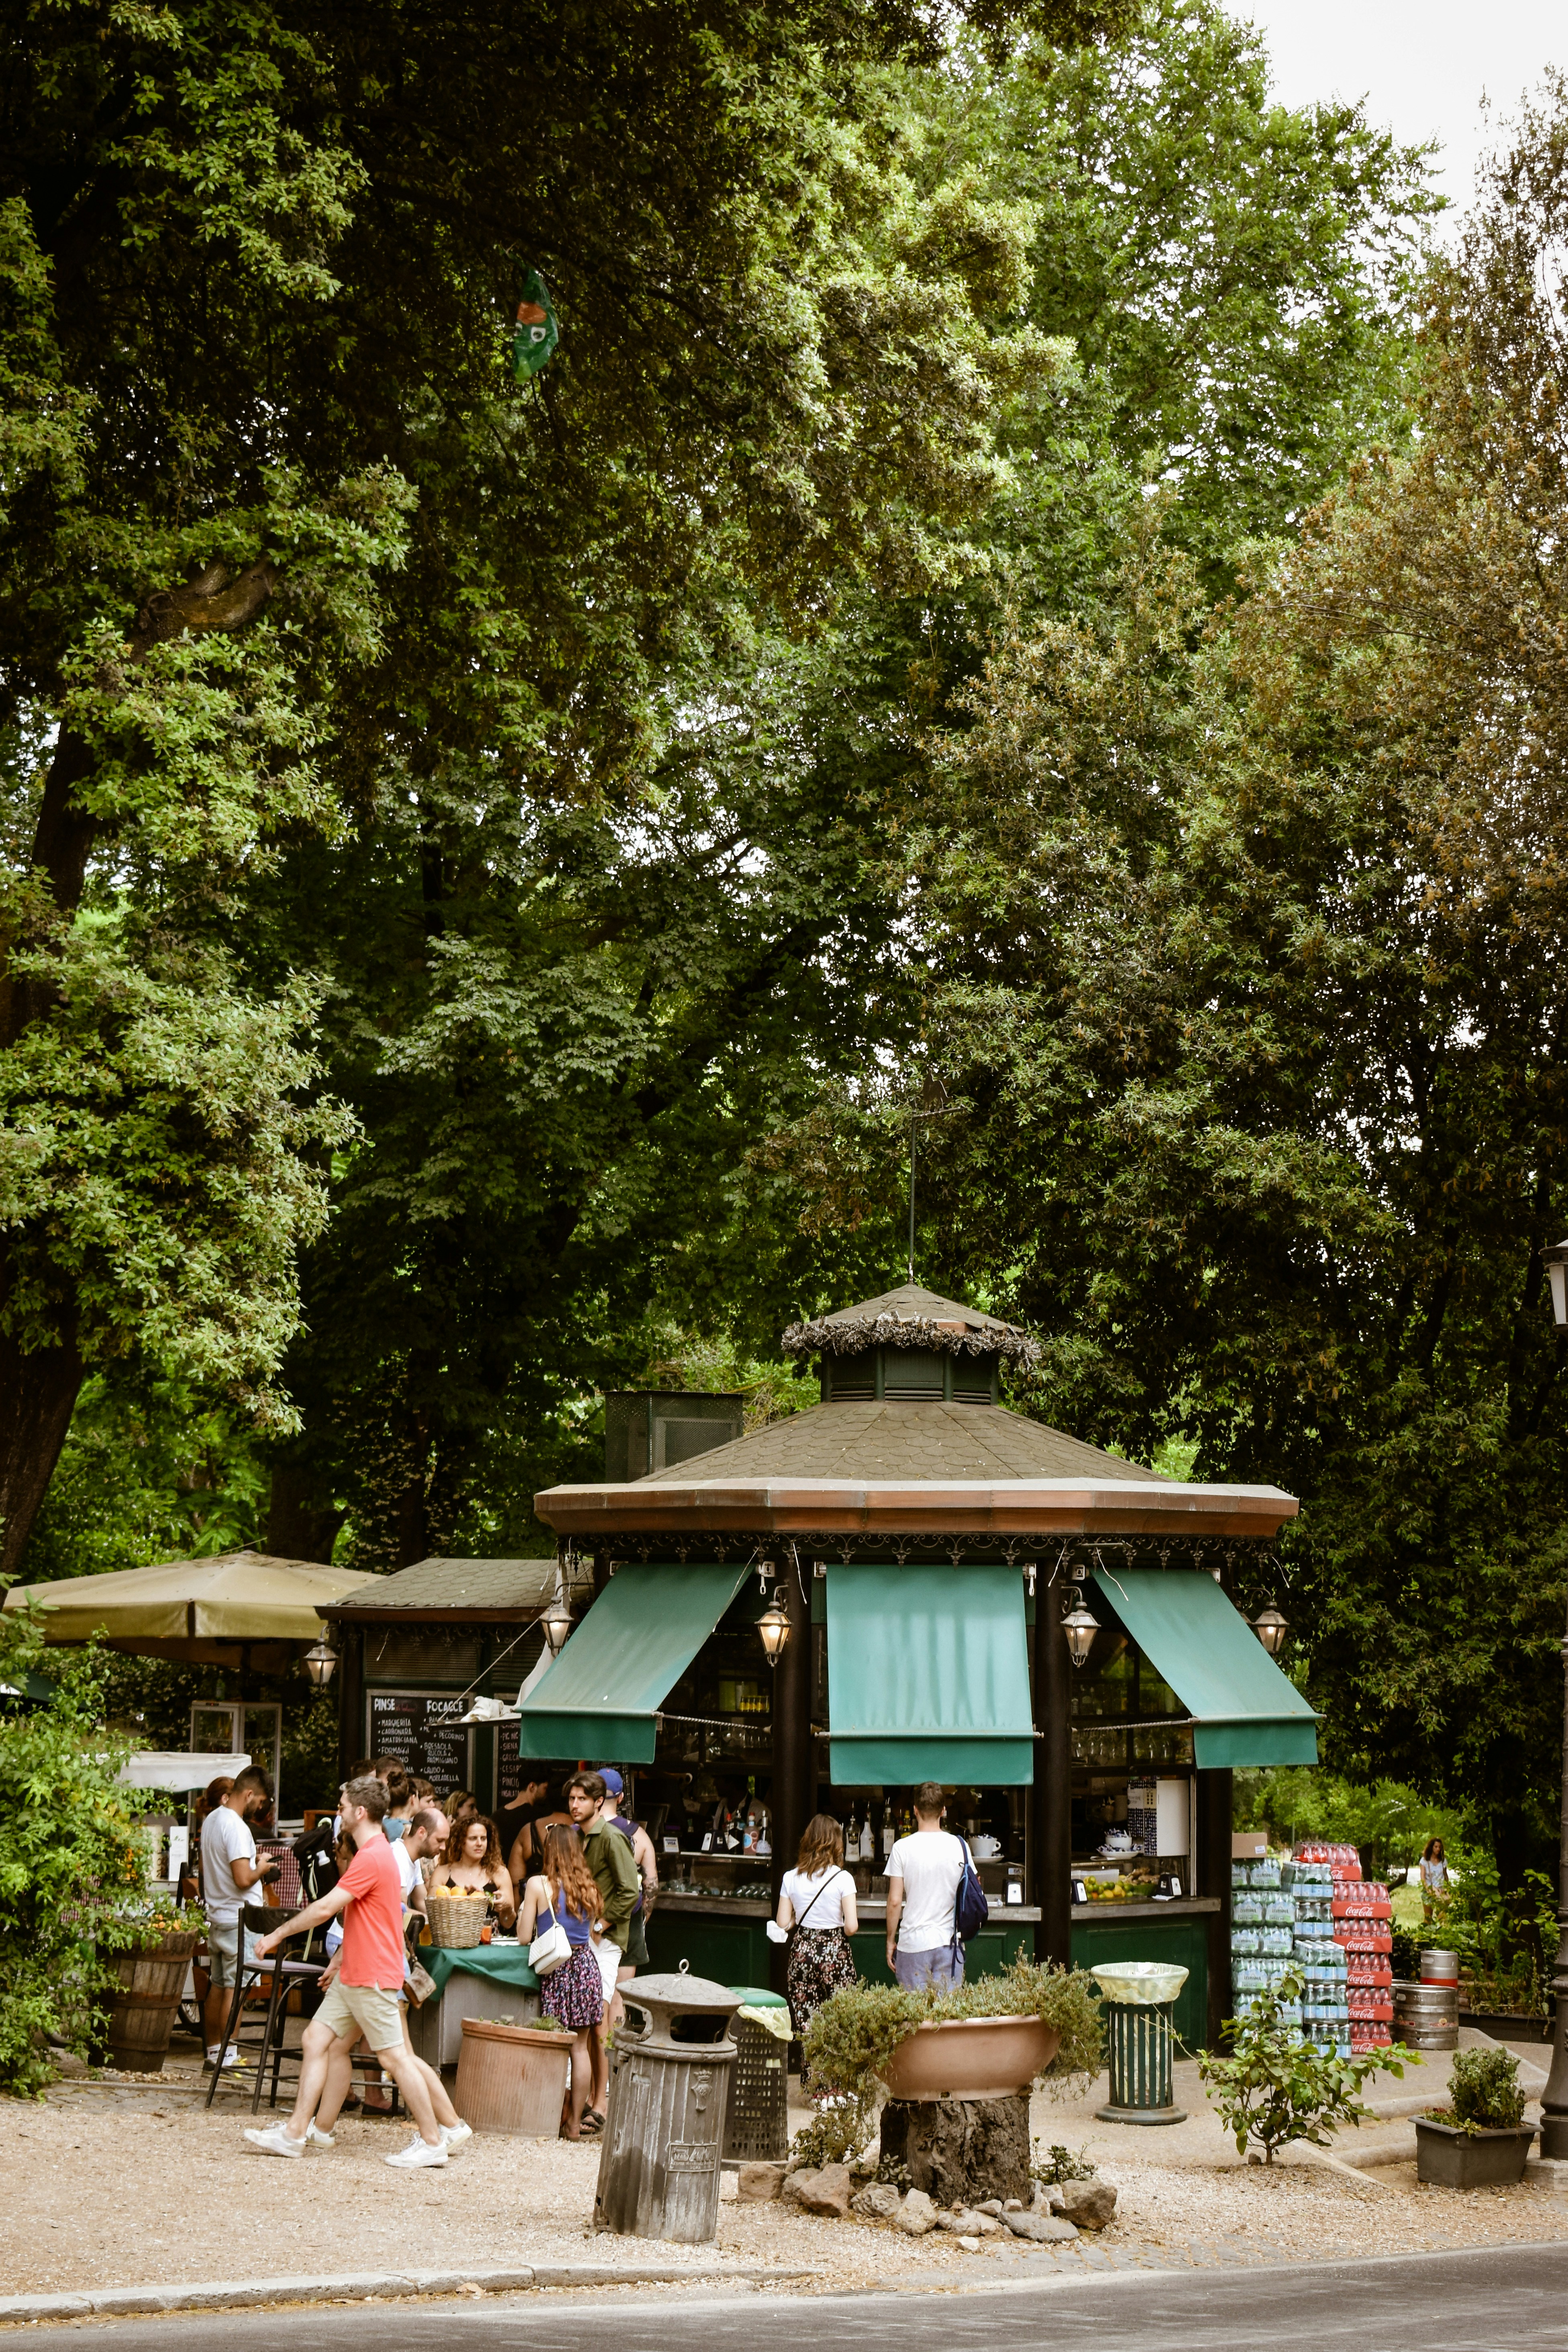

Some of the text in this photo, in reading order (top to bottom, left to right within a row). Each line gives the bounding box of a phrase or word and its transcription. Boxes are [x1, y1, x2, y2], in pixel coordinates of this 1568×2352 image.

[374, 1698, 396, 1711] PINSE
[427, 1700, 463, 1713] FOCACCE
[381, 1718, 412, 1727] MARGHERITA
[381, 1727, 412, 1735] CARBONARA
[439, 1732, 465, 1741] PECORINO
[503, 1742, 518, 1750] SIENA
[502, 1754, 520, 1762] GRECA
[428, 1774, 459, 1782] MOZZARELLA
